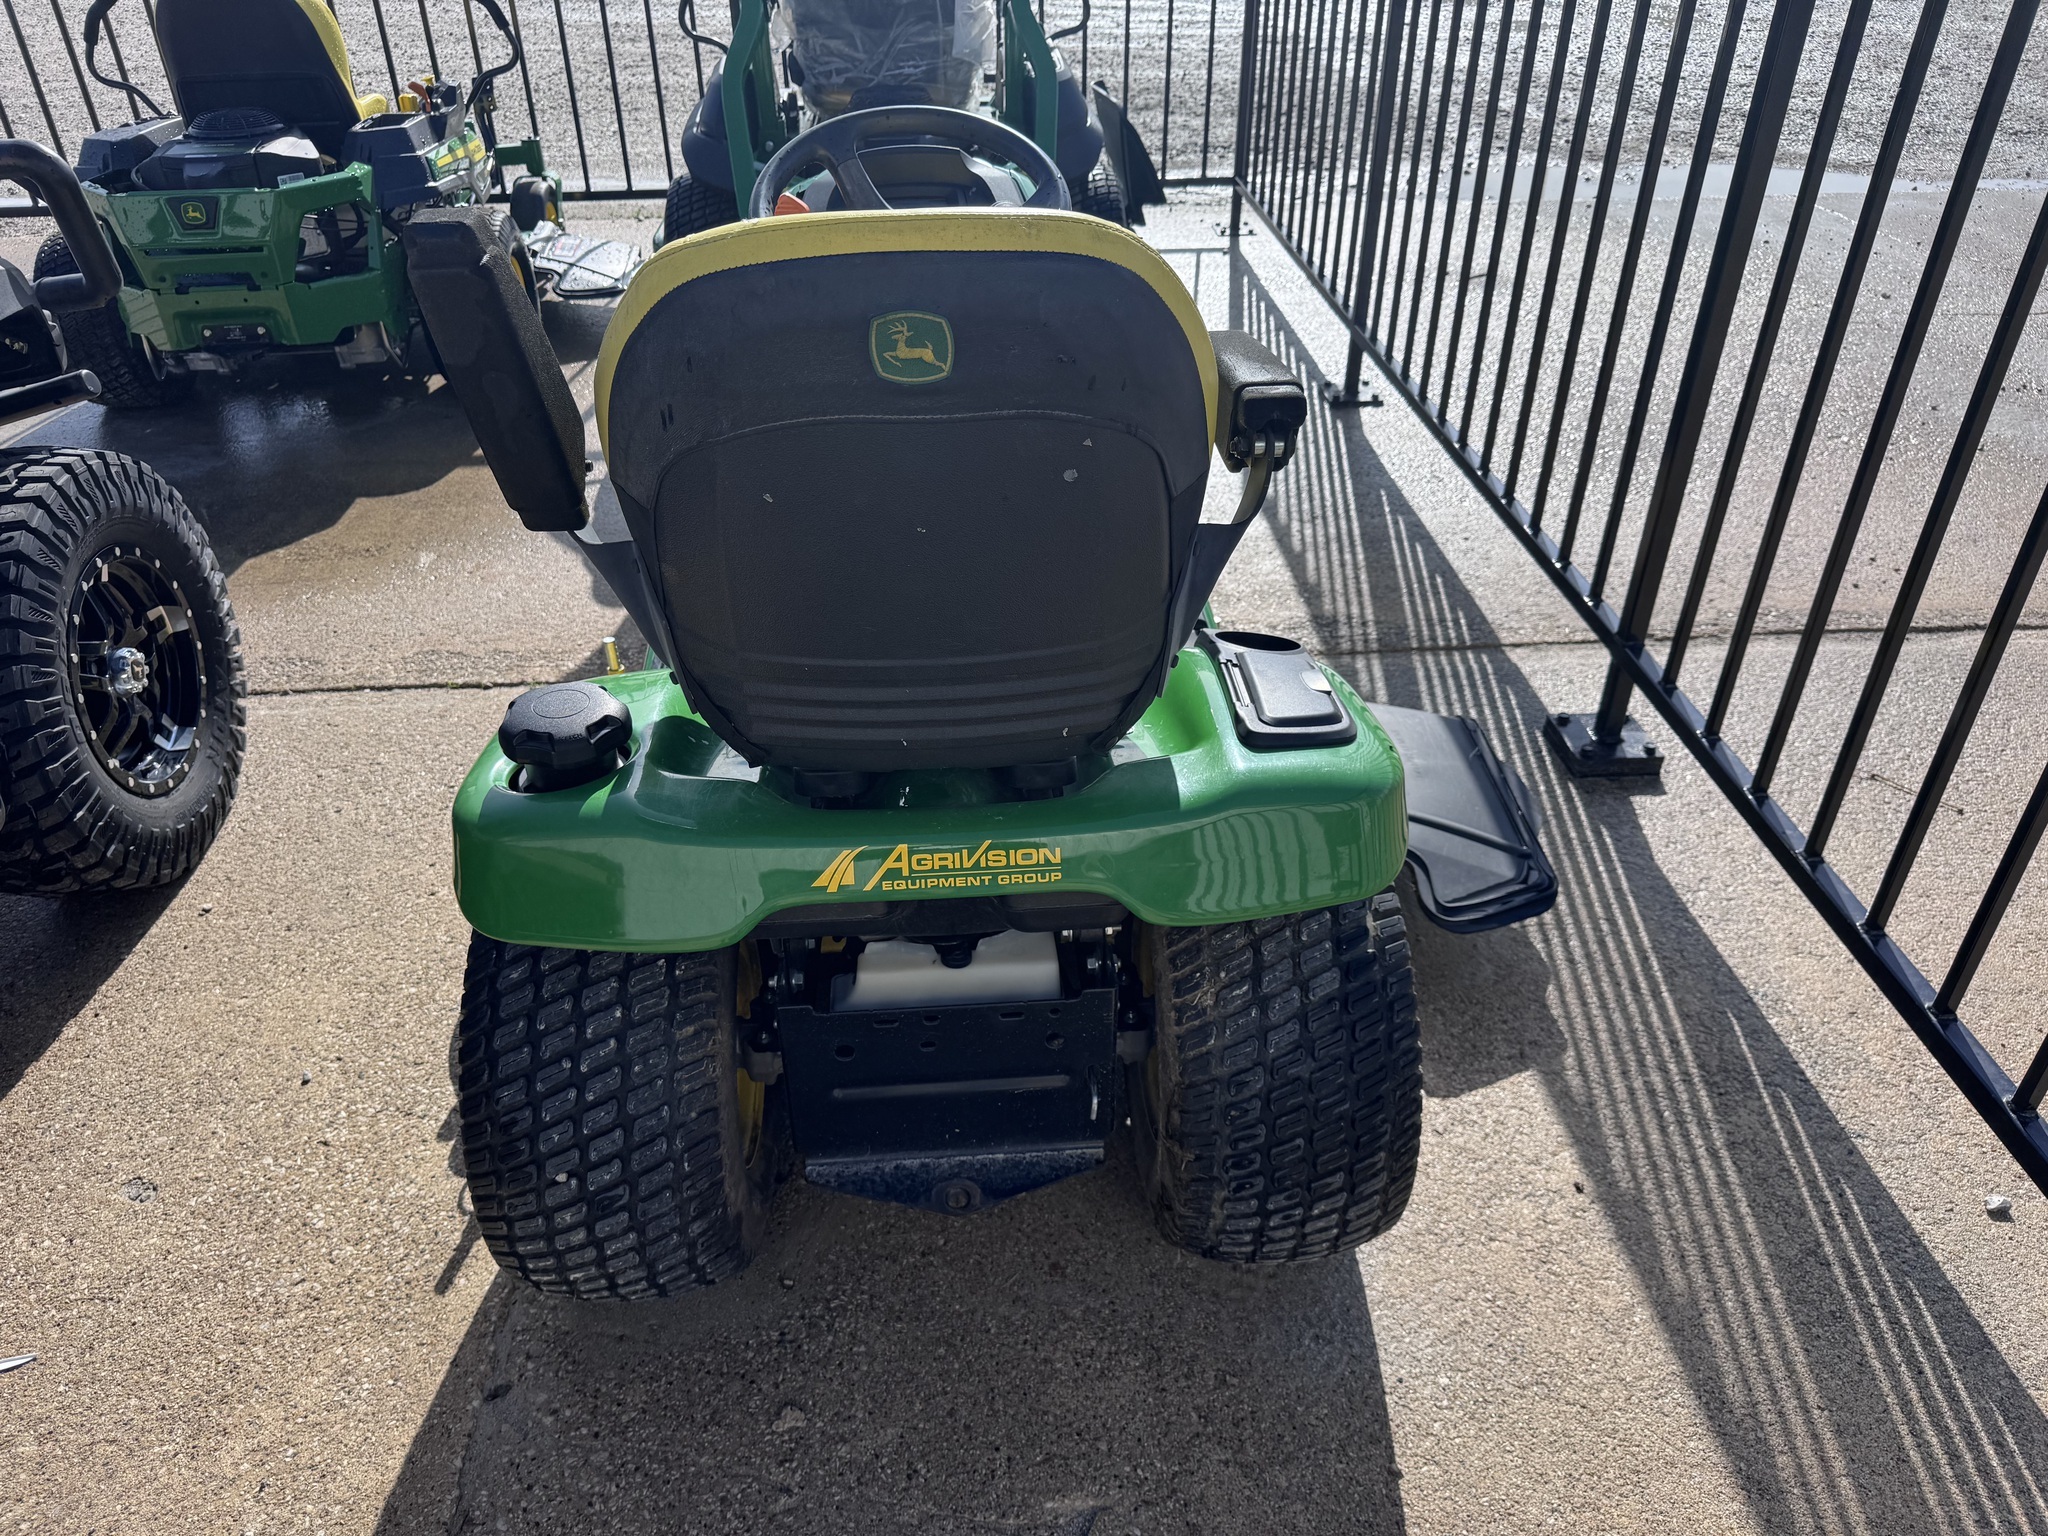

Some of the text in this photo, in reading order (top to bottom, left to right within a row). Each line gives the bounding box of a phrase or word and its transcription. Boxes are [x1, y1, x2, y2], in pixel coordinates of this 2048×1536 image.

[863, 840, 1061, 891] AGRIVISION
[882, 872, 1062, 891] EQUIPMENT GROUP
